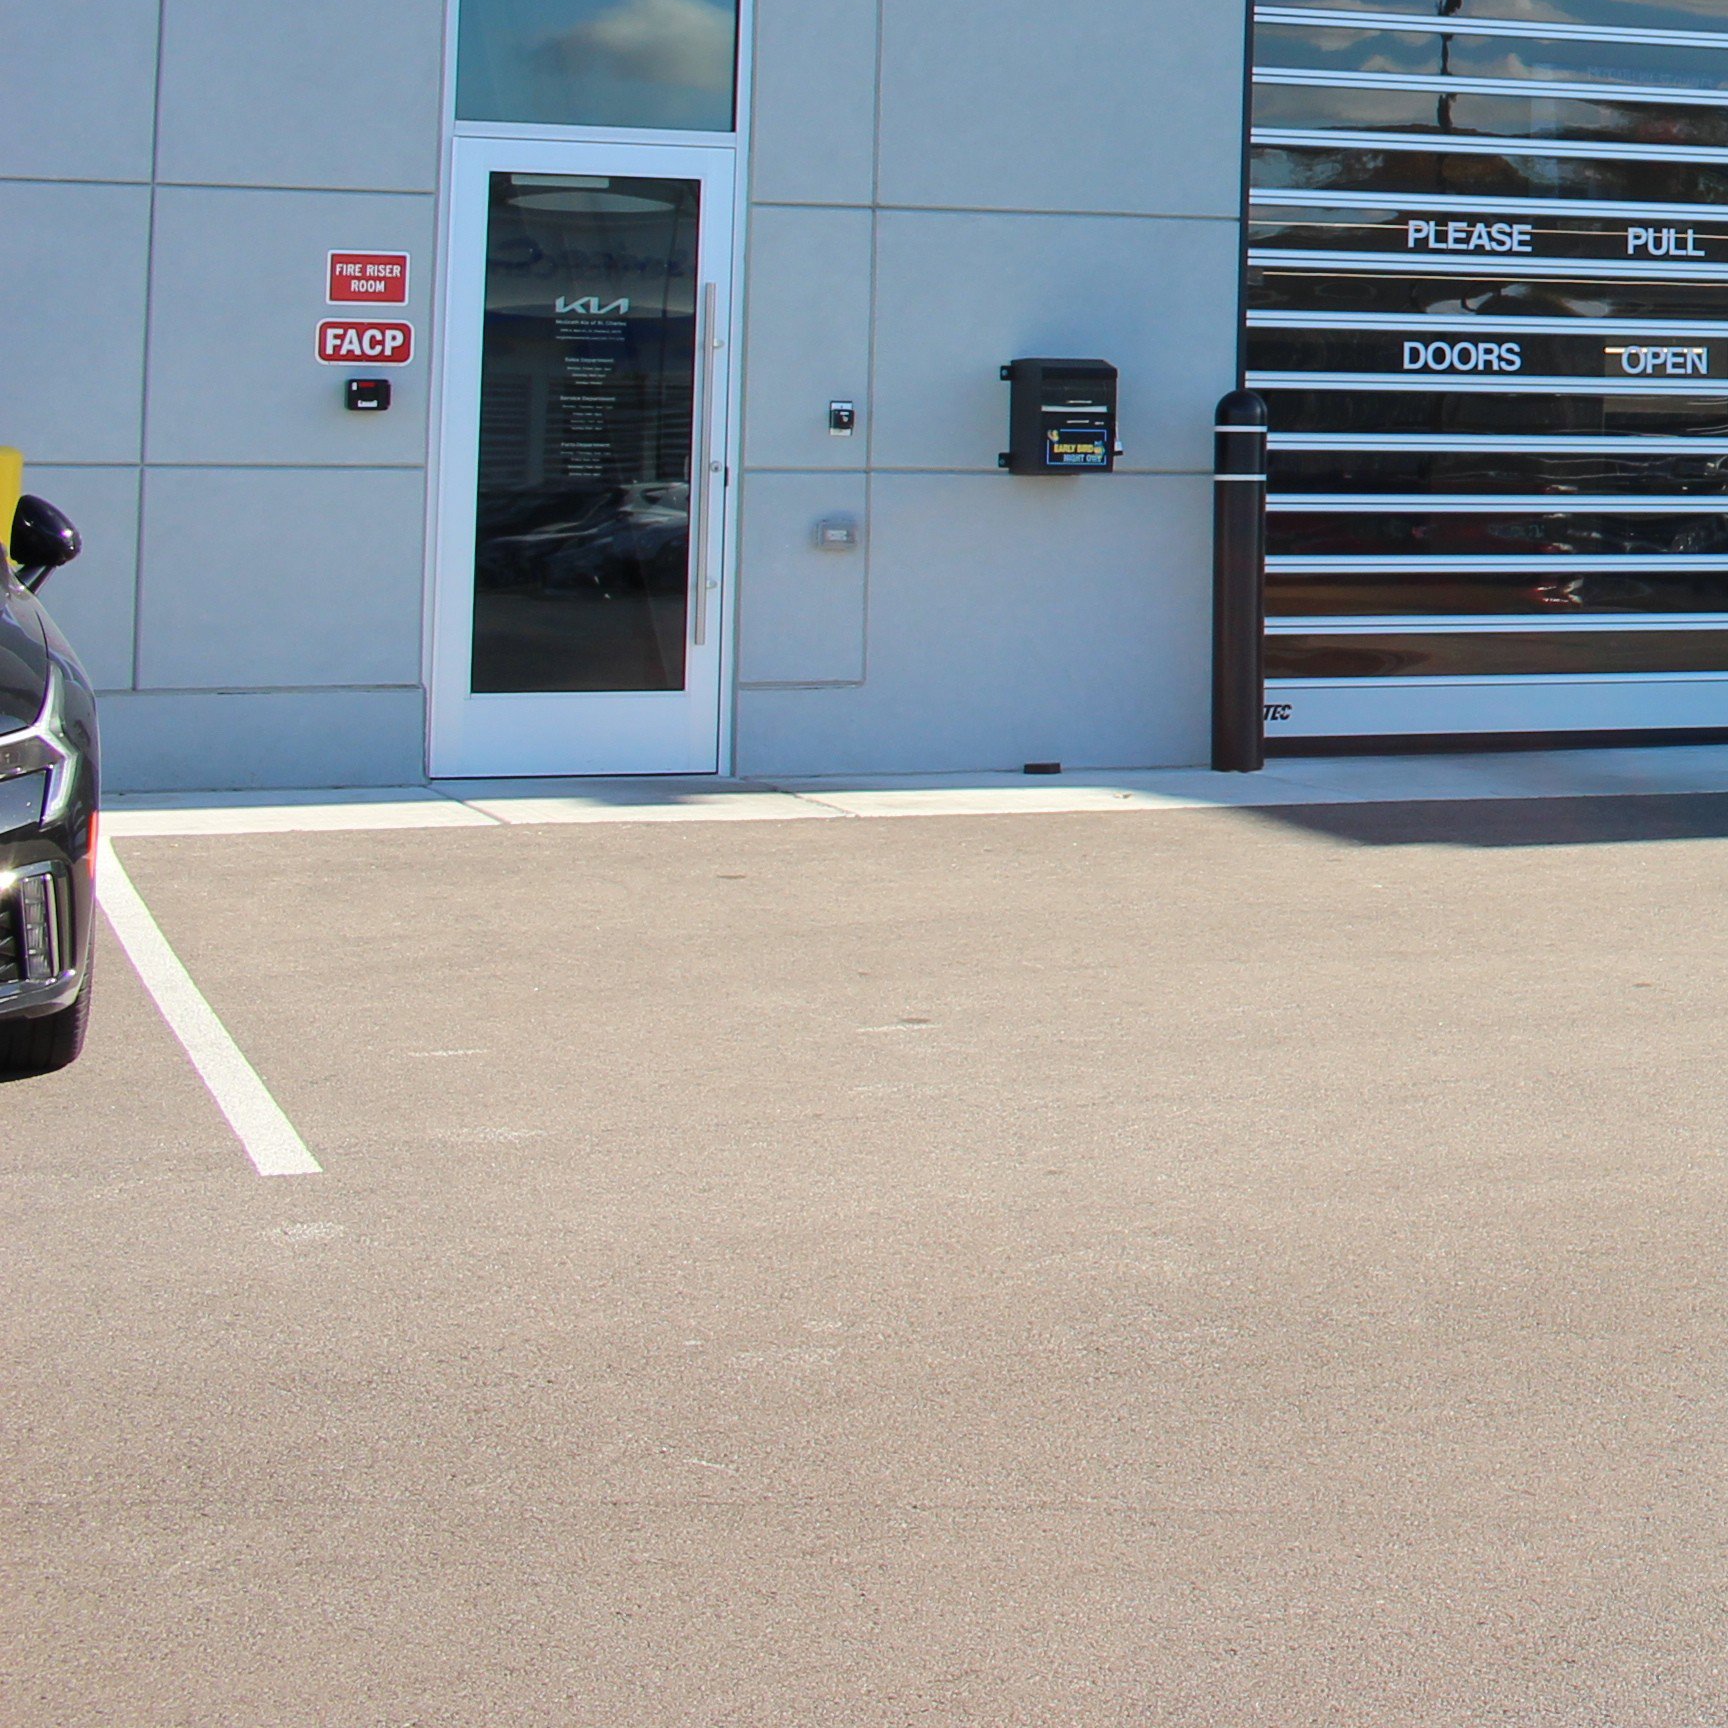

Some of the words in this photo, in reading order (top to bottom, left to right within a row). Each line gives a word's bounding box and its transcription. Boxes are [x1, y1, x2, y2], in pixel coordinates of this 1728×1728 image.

[1407, 219, 1533, 253] PLEASE
[1627, 227, 1706, 257] PULL
[335, 263, 362, 276] FIRE
[366, 264, 401, 277] RISER
[350, 279, 385, 293] ROOM
[555, 295, 629, 315] KIA
[325, 327, 404, 357] FACP
[1403, 340, 1522, 373] DOORS
[1621, 345, 1709, 375] OPEN
[1053, 444, 1076, 453] EARLY
[1264, 704, 1292, 721] TEC
